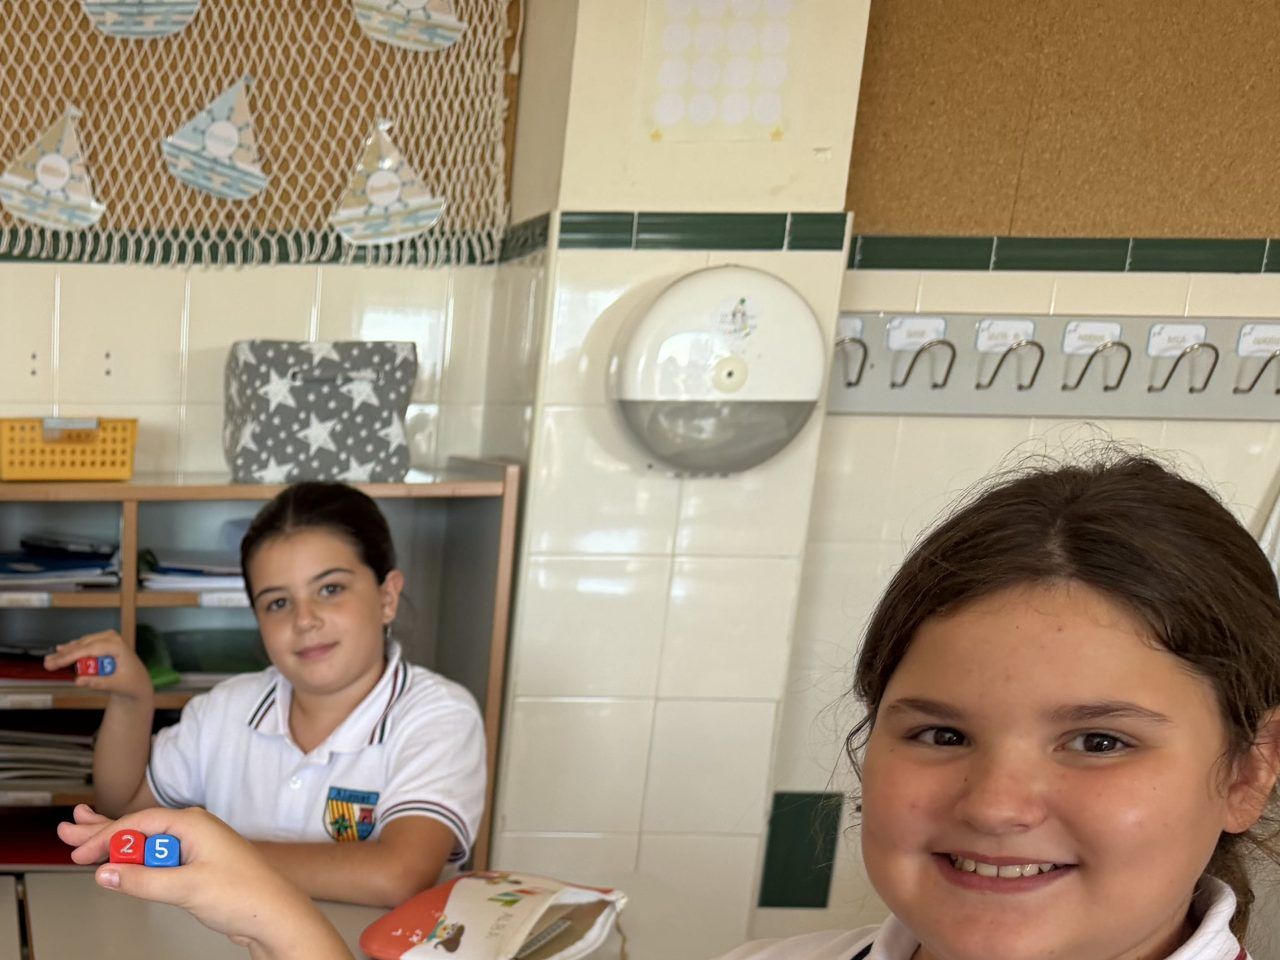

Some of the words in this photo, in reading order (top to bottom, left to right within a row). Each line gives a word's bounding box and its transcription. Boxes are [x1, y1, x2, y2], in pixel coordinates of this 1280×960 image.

[87, 660, 96, 674] 2
[120, 834, 135, 853] 2
[154, 838, 169, 859] 5
